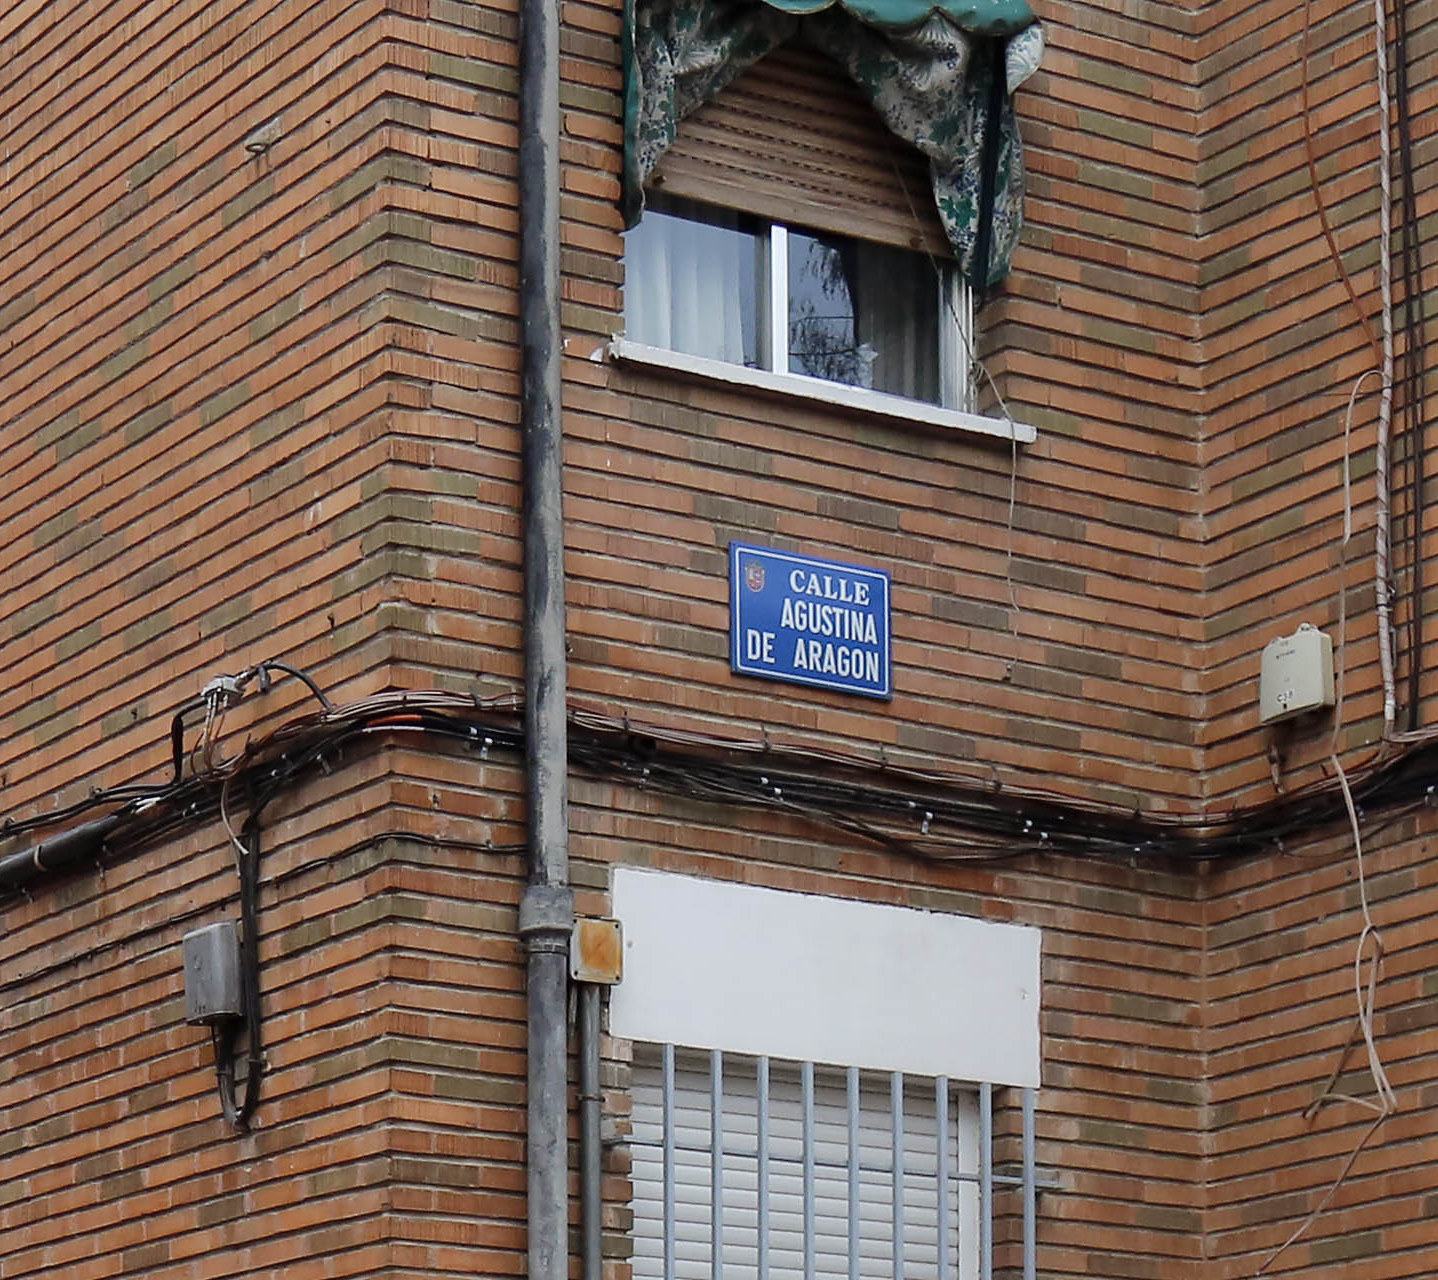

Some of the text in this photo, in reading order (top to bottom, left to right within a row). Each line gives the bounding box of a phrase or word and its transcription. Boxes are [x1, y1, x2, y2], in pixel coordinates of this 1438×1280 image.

[790, 569, 870, 606] CALLE
[781, 598, 878, 645] AGUSTINA
[747, 629, 879, 682] DE ARAGON
